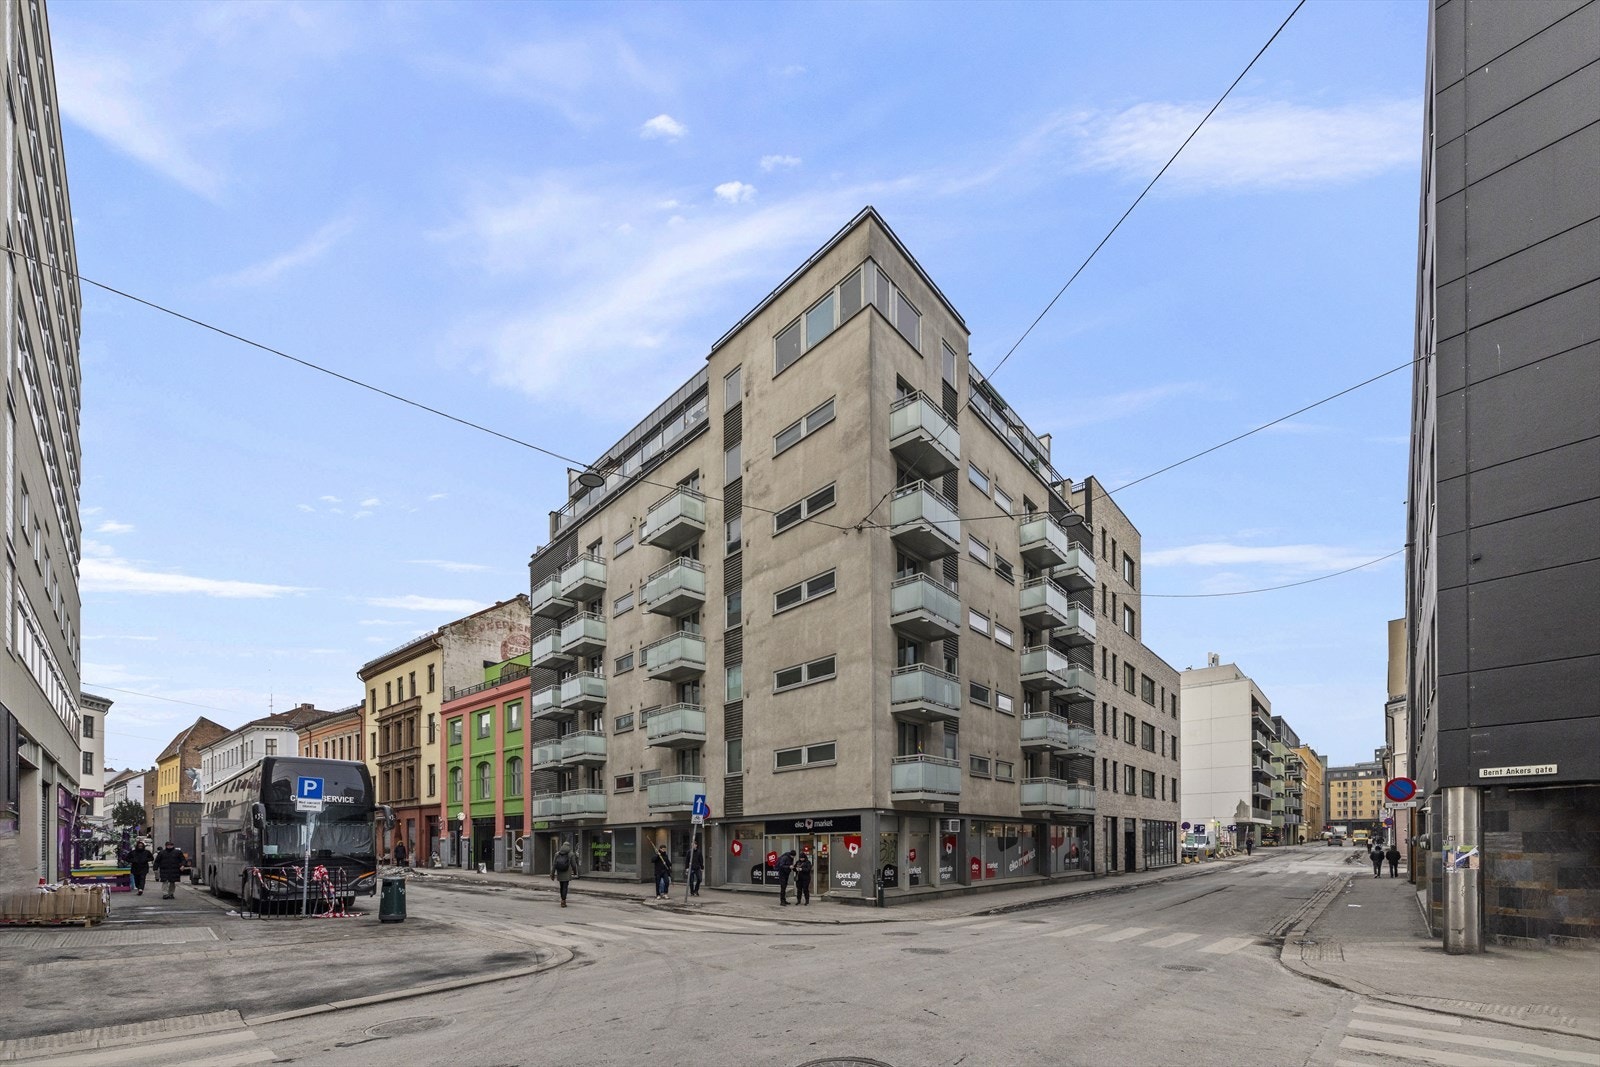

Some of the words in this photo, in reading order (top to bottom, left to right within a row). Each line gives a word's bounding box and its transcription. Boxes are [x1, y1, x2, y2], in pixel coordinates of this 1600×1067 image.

[1506, 767, 1531, 775] Ankers
[1535, 766, 1553, 774] gate
[303, 779, 318, 796] P
[322, 795, 355, 804] SERVICE
[814, 819, 833, 828] market
[835, 870, 851, 880] åpent
[851, 871, 861, 880] alle
[840, 879, 857, 888] dager
